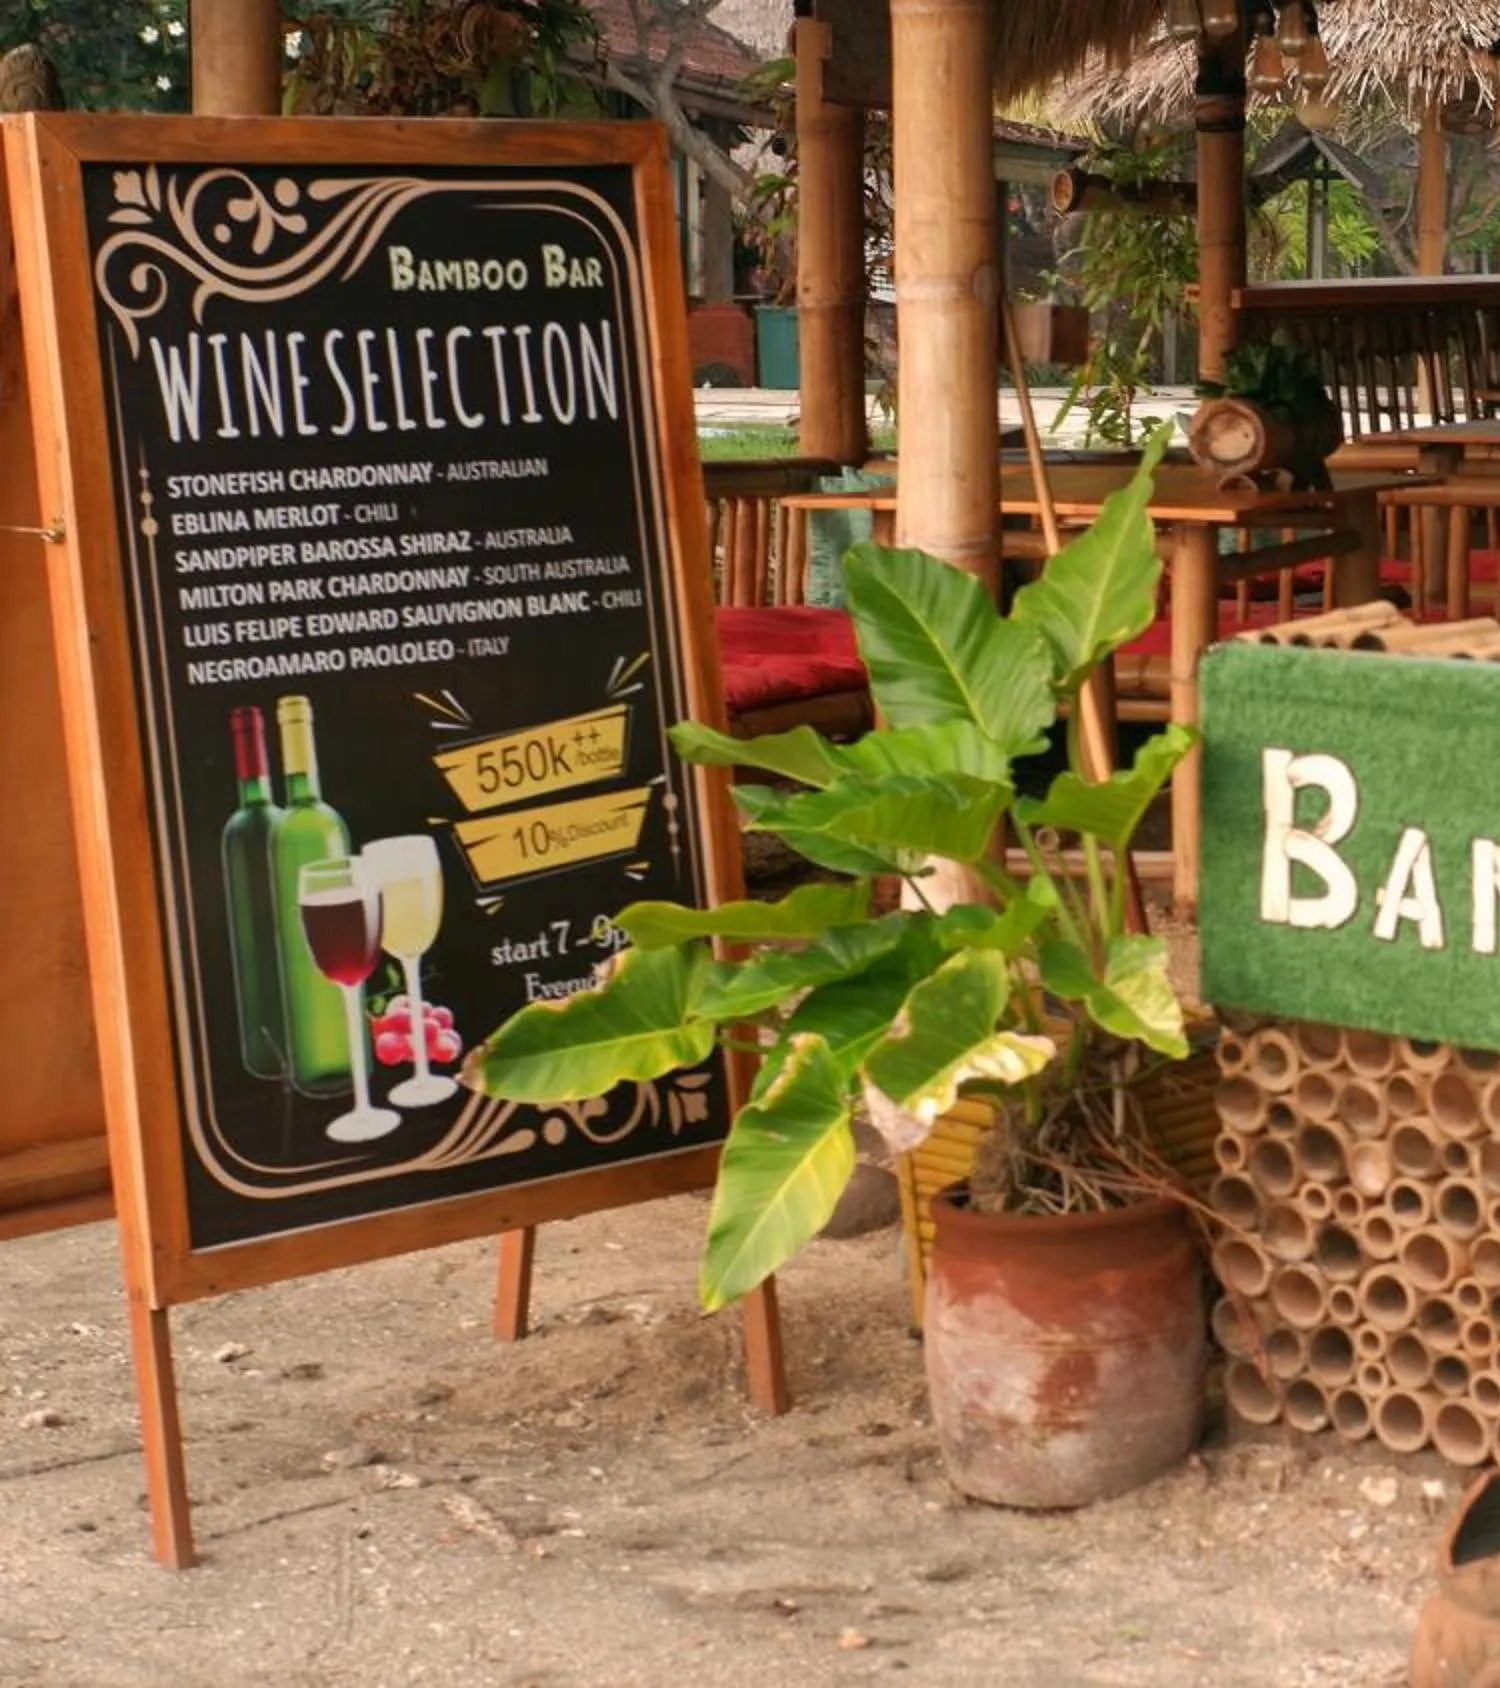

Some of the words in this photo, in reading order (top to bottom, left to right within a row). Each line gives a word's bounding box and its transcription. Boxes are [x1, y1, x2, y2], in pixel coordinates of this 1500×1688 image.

[389, 245, 528, 291] BAMBOO
[542, 243, 604, 288] BAR
[168, 470, 285, 498] STONEFISH
[290, 462, 433, 491] CHARDONNAY
[447, 458, 549, 481] AUSTRALIAN
[172, 509, 250, 536] EBLINA
[253, 504, 341, 530] MERLOT
[354, 503, 398, 523] CHILI
[175, 543, 297, 573] SANDPIPER
[300, 536, 397, 563] BAROSSA
[400, 531, 472, 556] SHIRAZ
[484, 525, 574, 550] AUSTRALIA
[179, 583, 264, 611] MILTON
[268, 578, 325, 602] PARK
[327, 566, 470, 598] CHARDONNAY
[483, 562, 541, 586] SOUTH
[544, 555, 631, 580] AUSTRALIA
[183, 622, 231, 648] LUIS
[235, 616, 302, 643] FELIPE
[306, 608, 399, 636] EDWARD
[402, 598, 524, 628] SAUVIGNON
[526, 591, 591, 617] BLANC
[601, 589, 643, 609] CHILI
[187, 649, 345, 686] NEGROAMARO
[351, 639, 454, 669] PAOLOLEO
[468, 636, 511, 658] ITALY
[492, 931, 550, 966] start
